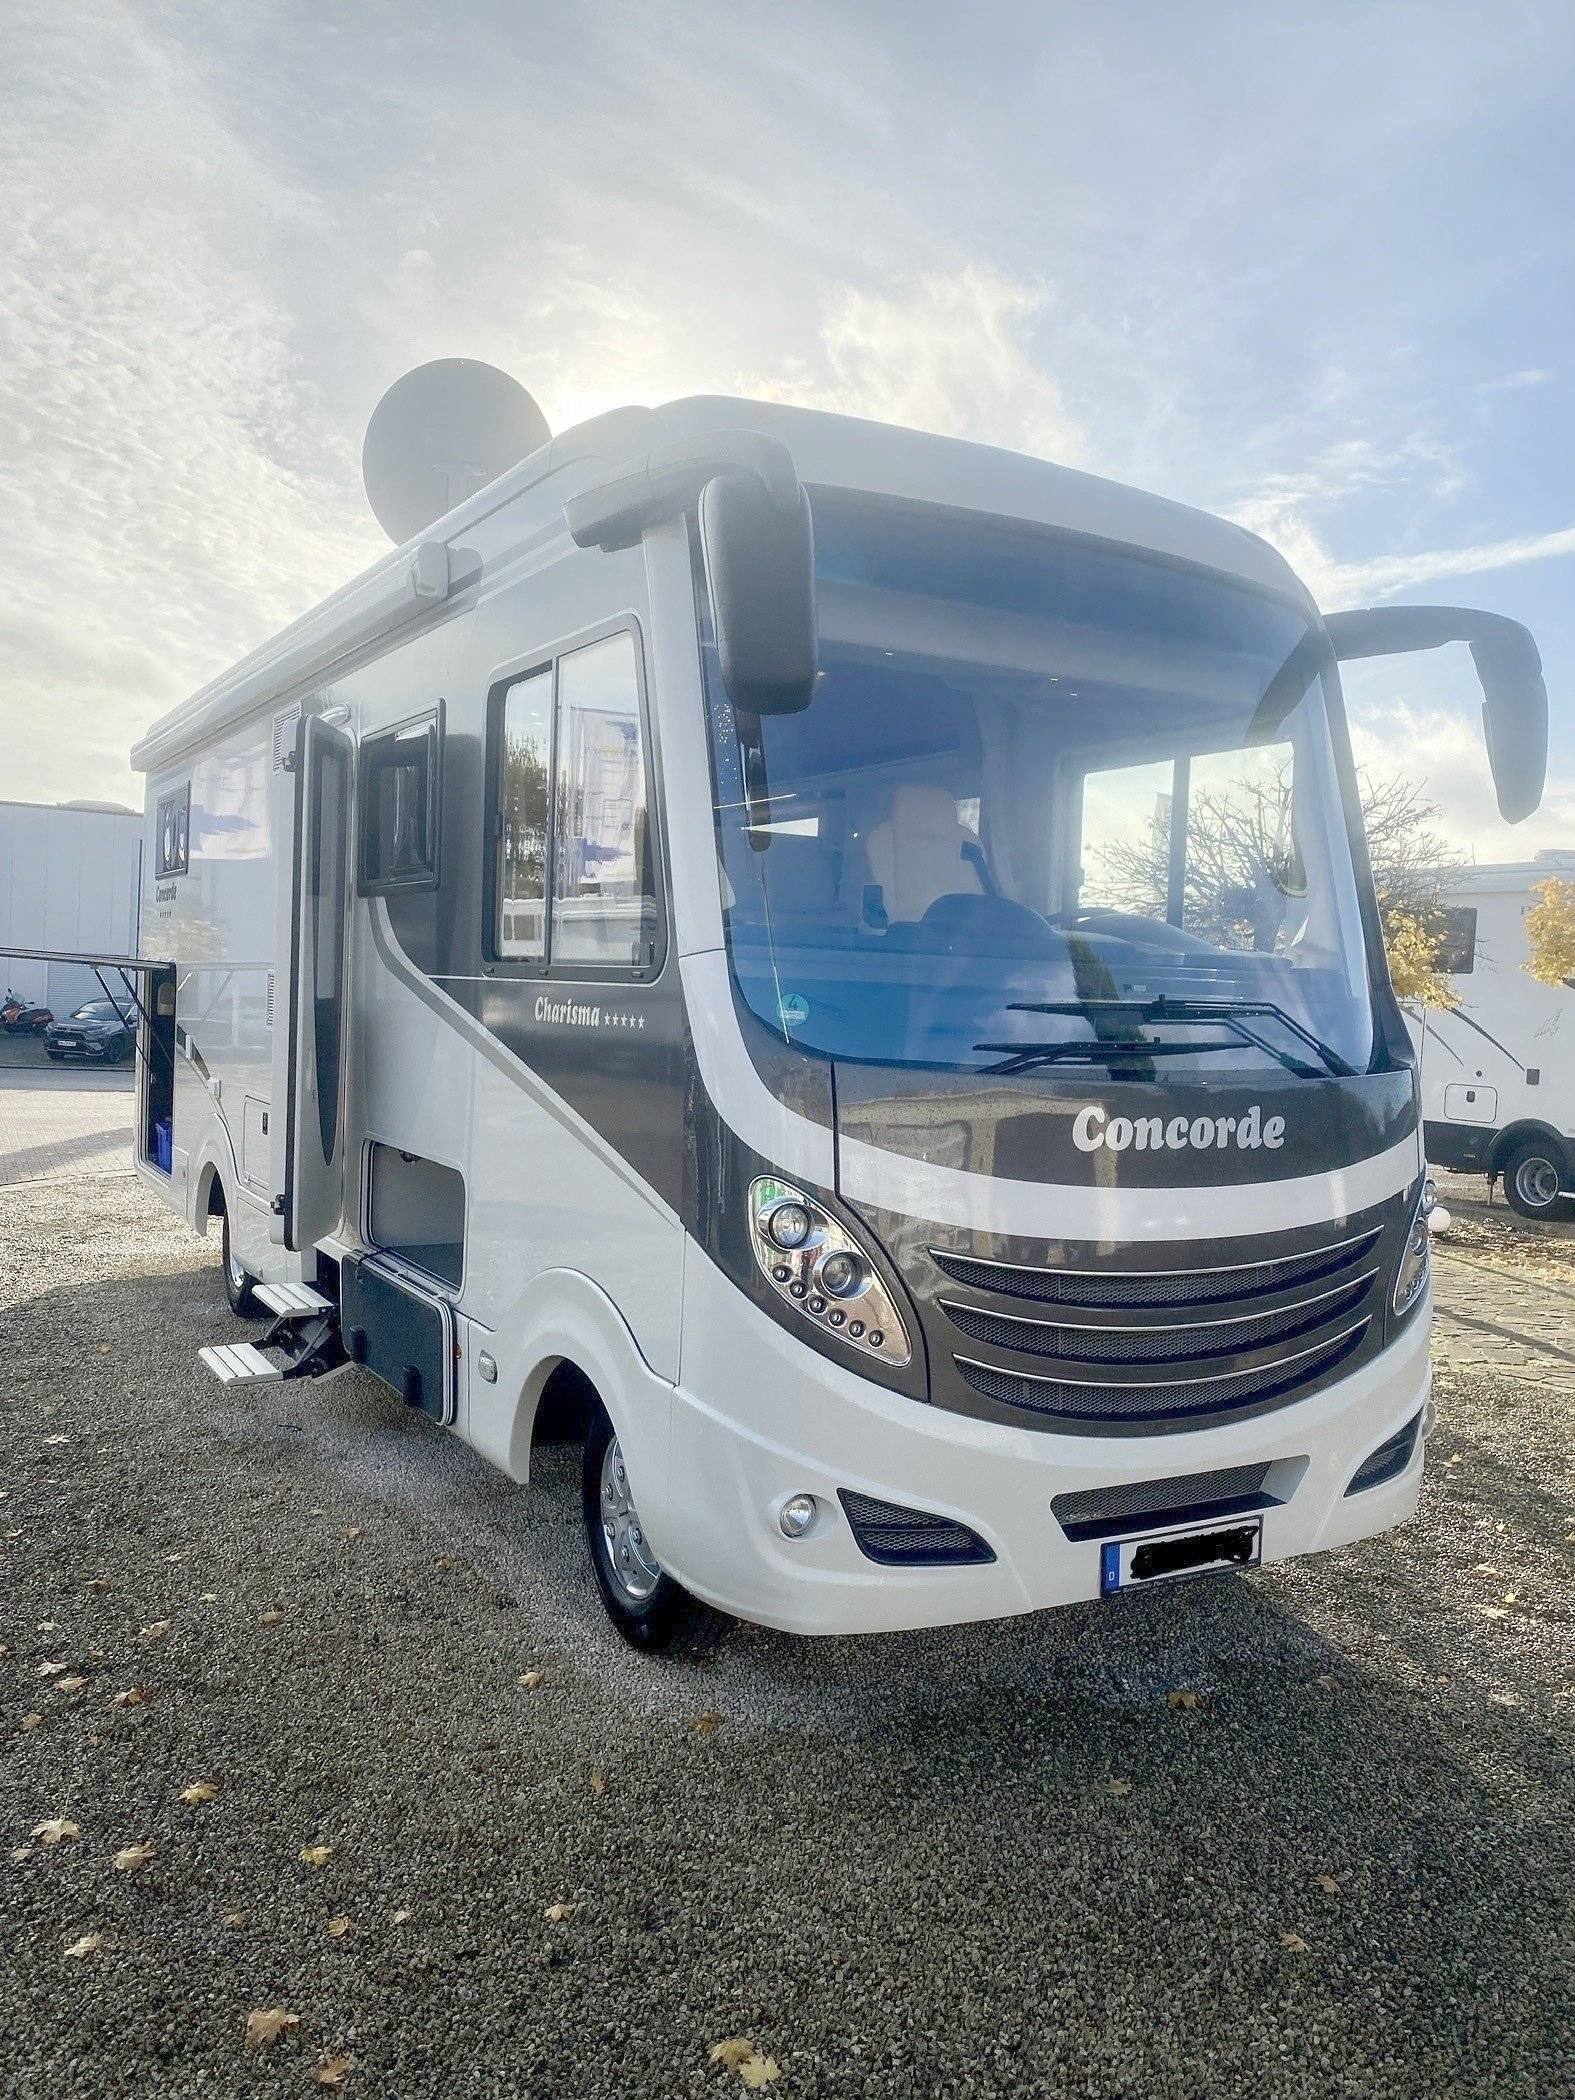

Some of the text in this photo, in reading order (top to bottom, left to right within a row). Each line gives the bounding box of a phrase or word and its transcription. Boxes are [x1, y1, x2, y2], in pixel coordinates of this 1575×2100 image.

[534, 996, 600, 1027] Charisma
[788, 995, 799, 1011] 4
[1072, 1105, 1286, 1151] Concorde
